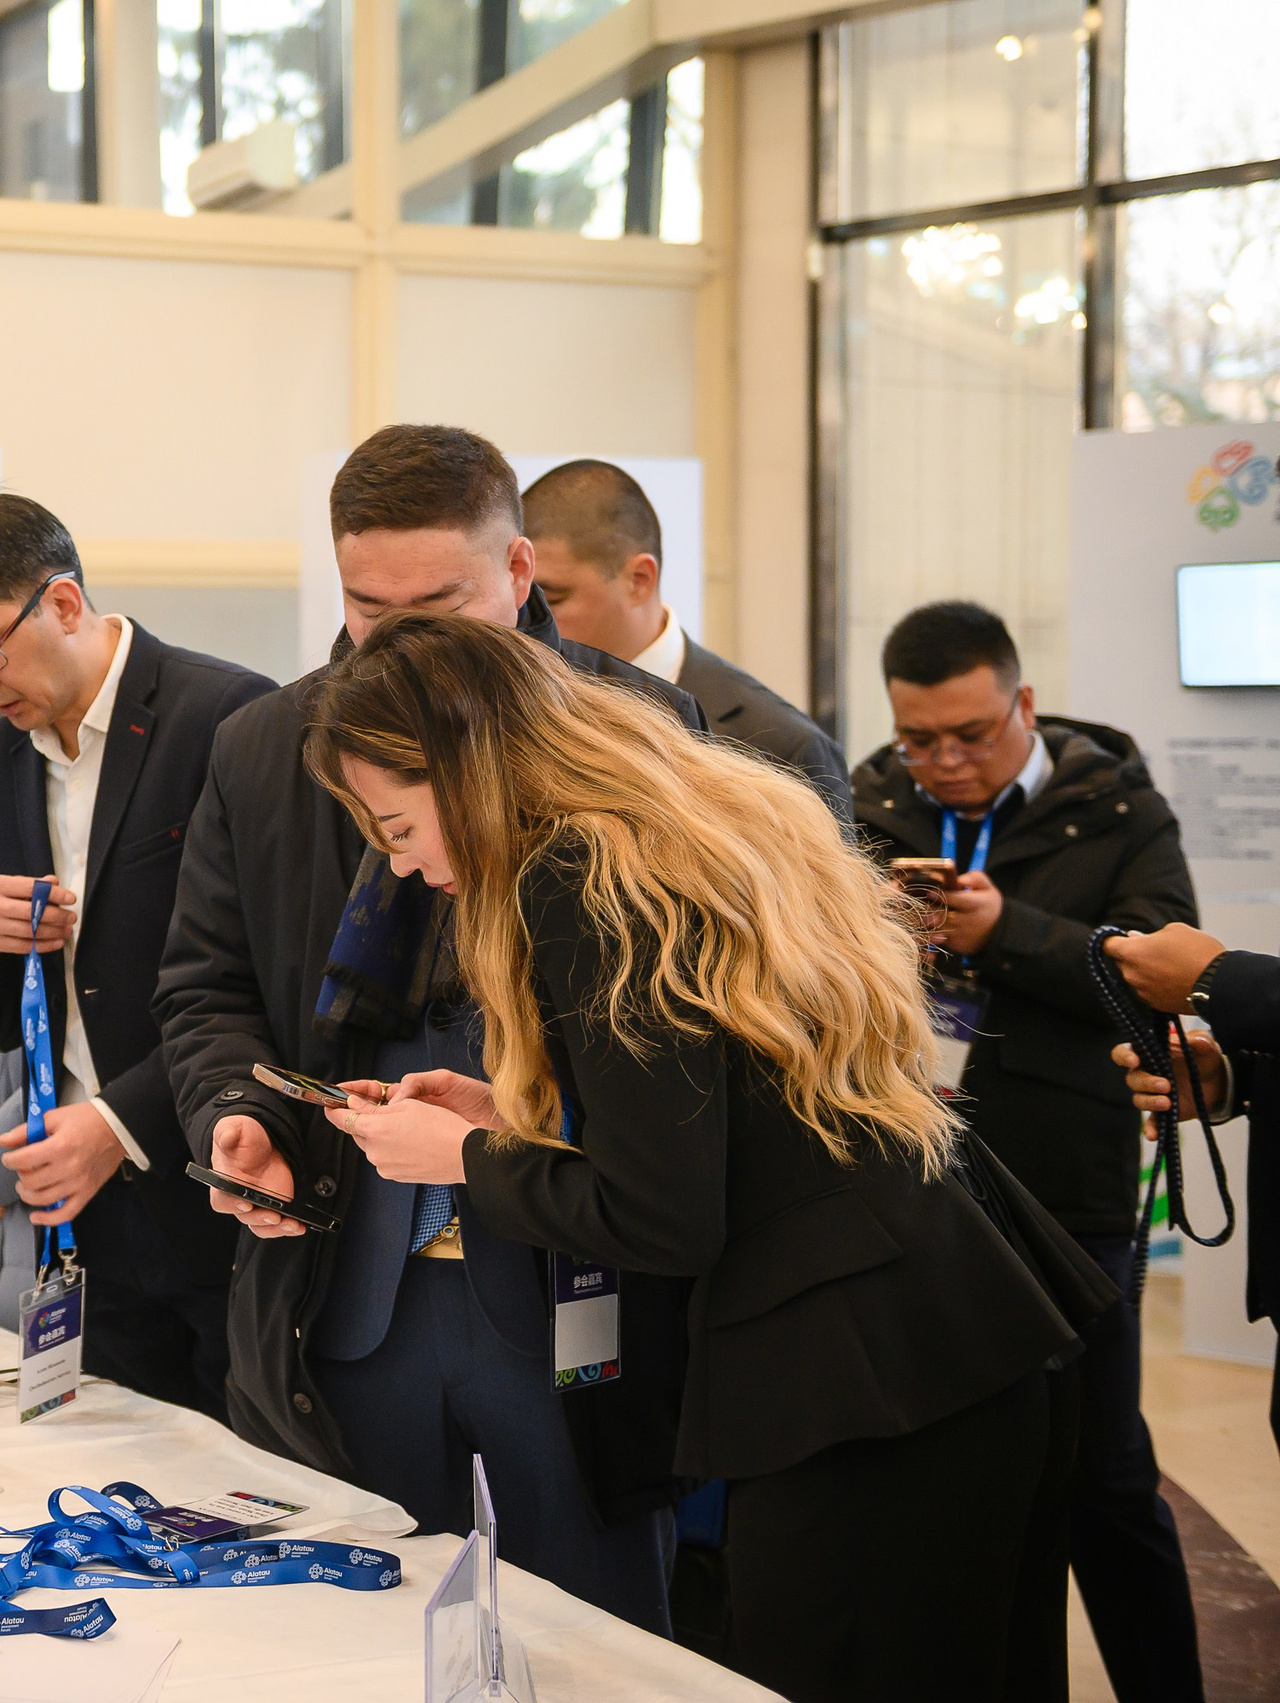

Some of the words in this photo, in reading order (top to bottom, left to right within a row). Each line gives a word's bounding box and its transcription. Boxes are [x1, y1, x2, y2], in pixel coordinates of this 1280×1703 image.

[70, 1532, 91, 1541] Alatau
[261, 1554, 278, 1562] Alata
[363, 1553, 382, 1563] Alatau
[247, 1570, 270, 1578] Alatau
[324, 1567, 343, 1577] Alatau
[0, 1617, 25, 1625] Alatau
[83, 1614, 104, 1632] Alatau
